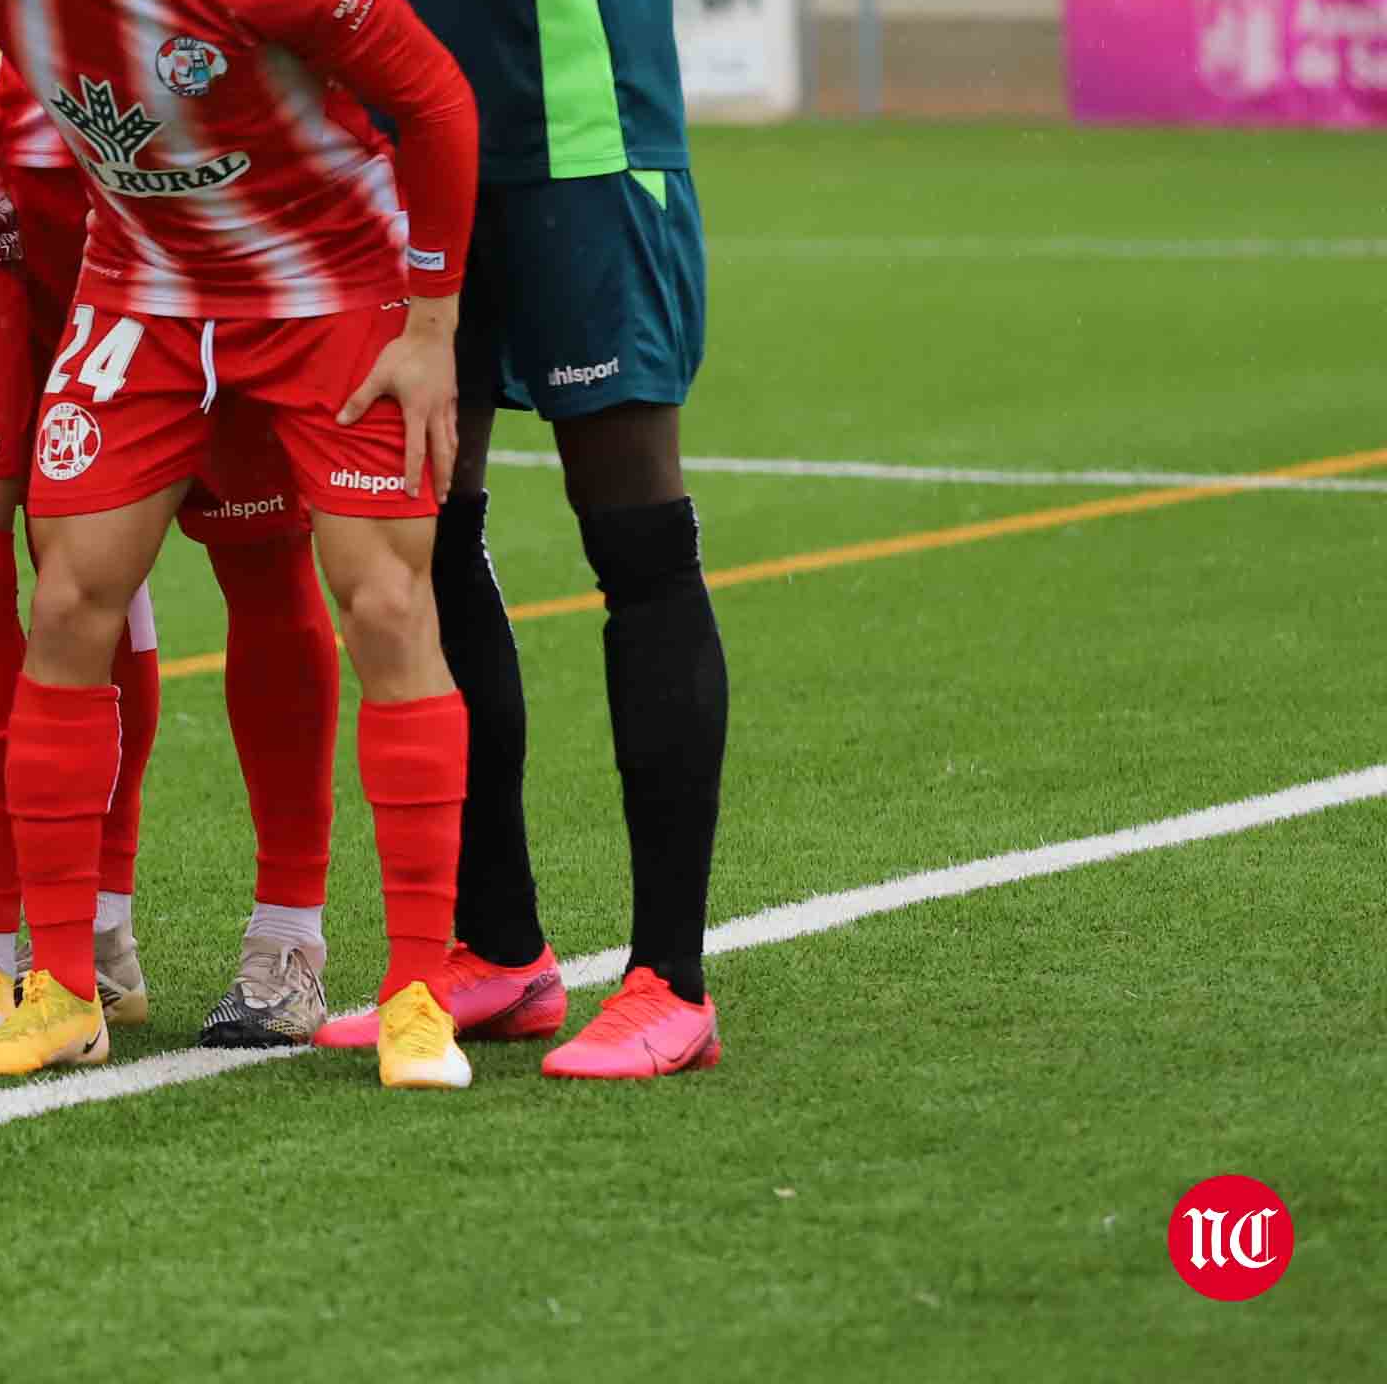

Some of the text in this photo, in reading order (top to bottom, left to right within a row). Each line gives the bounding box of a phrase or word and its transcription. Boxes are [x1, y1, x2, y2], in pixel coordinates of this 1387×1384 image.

[112, 153, 247, 194] RURAL
[44, 304, 146, 403] 24
[548, 357, 619, 388] uhlsport
